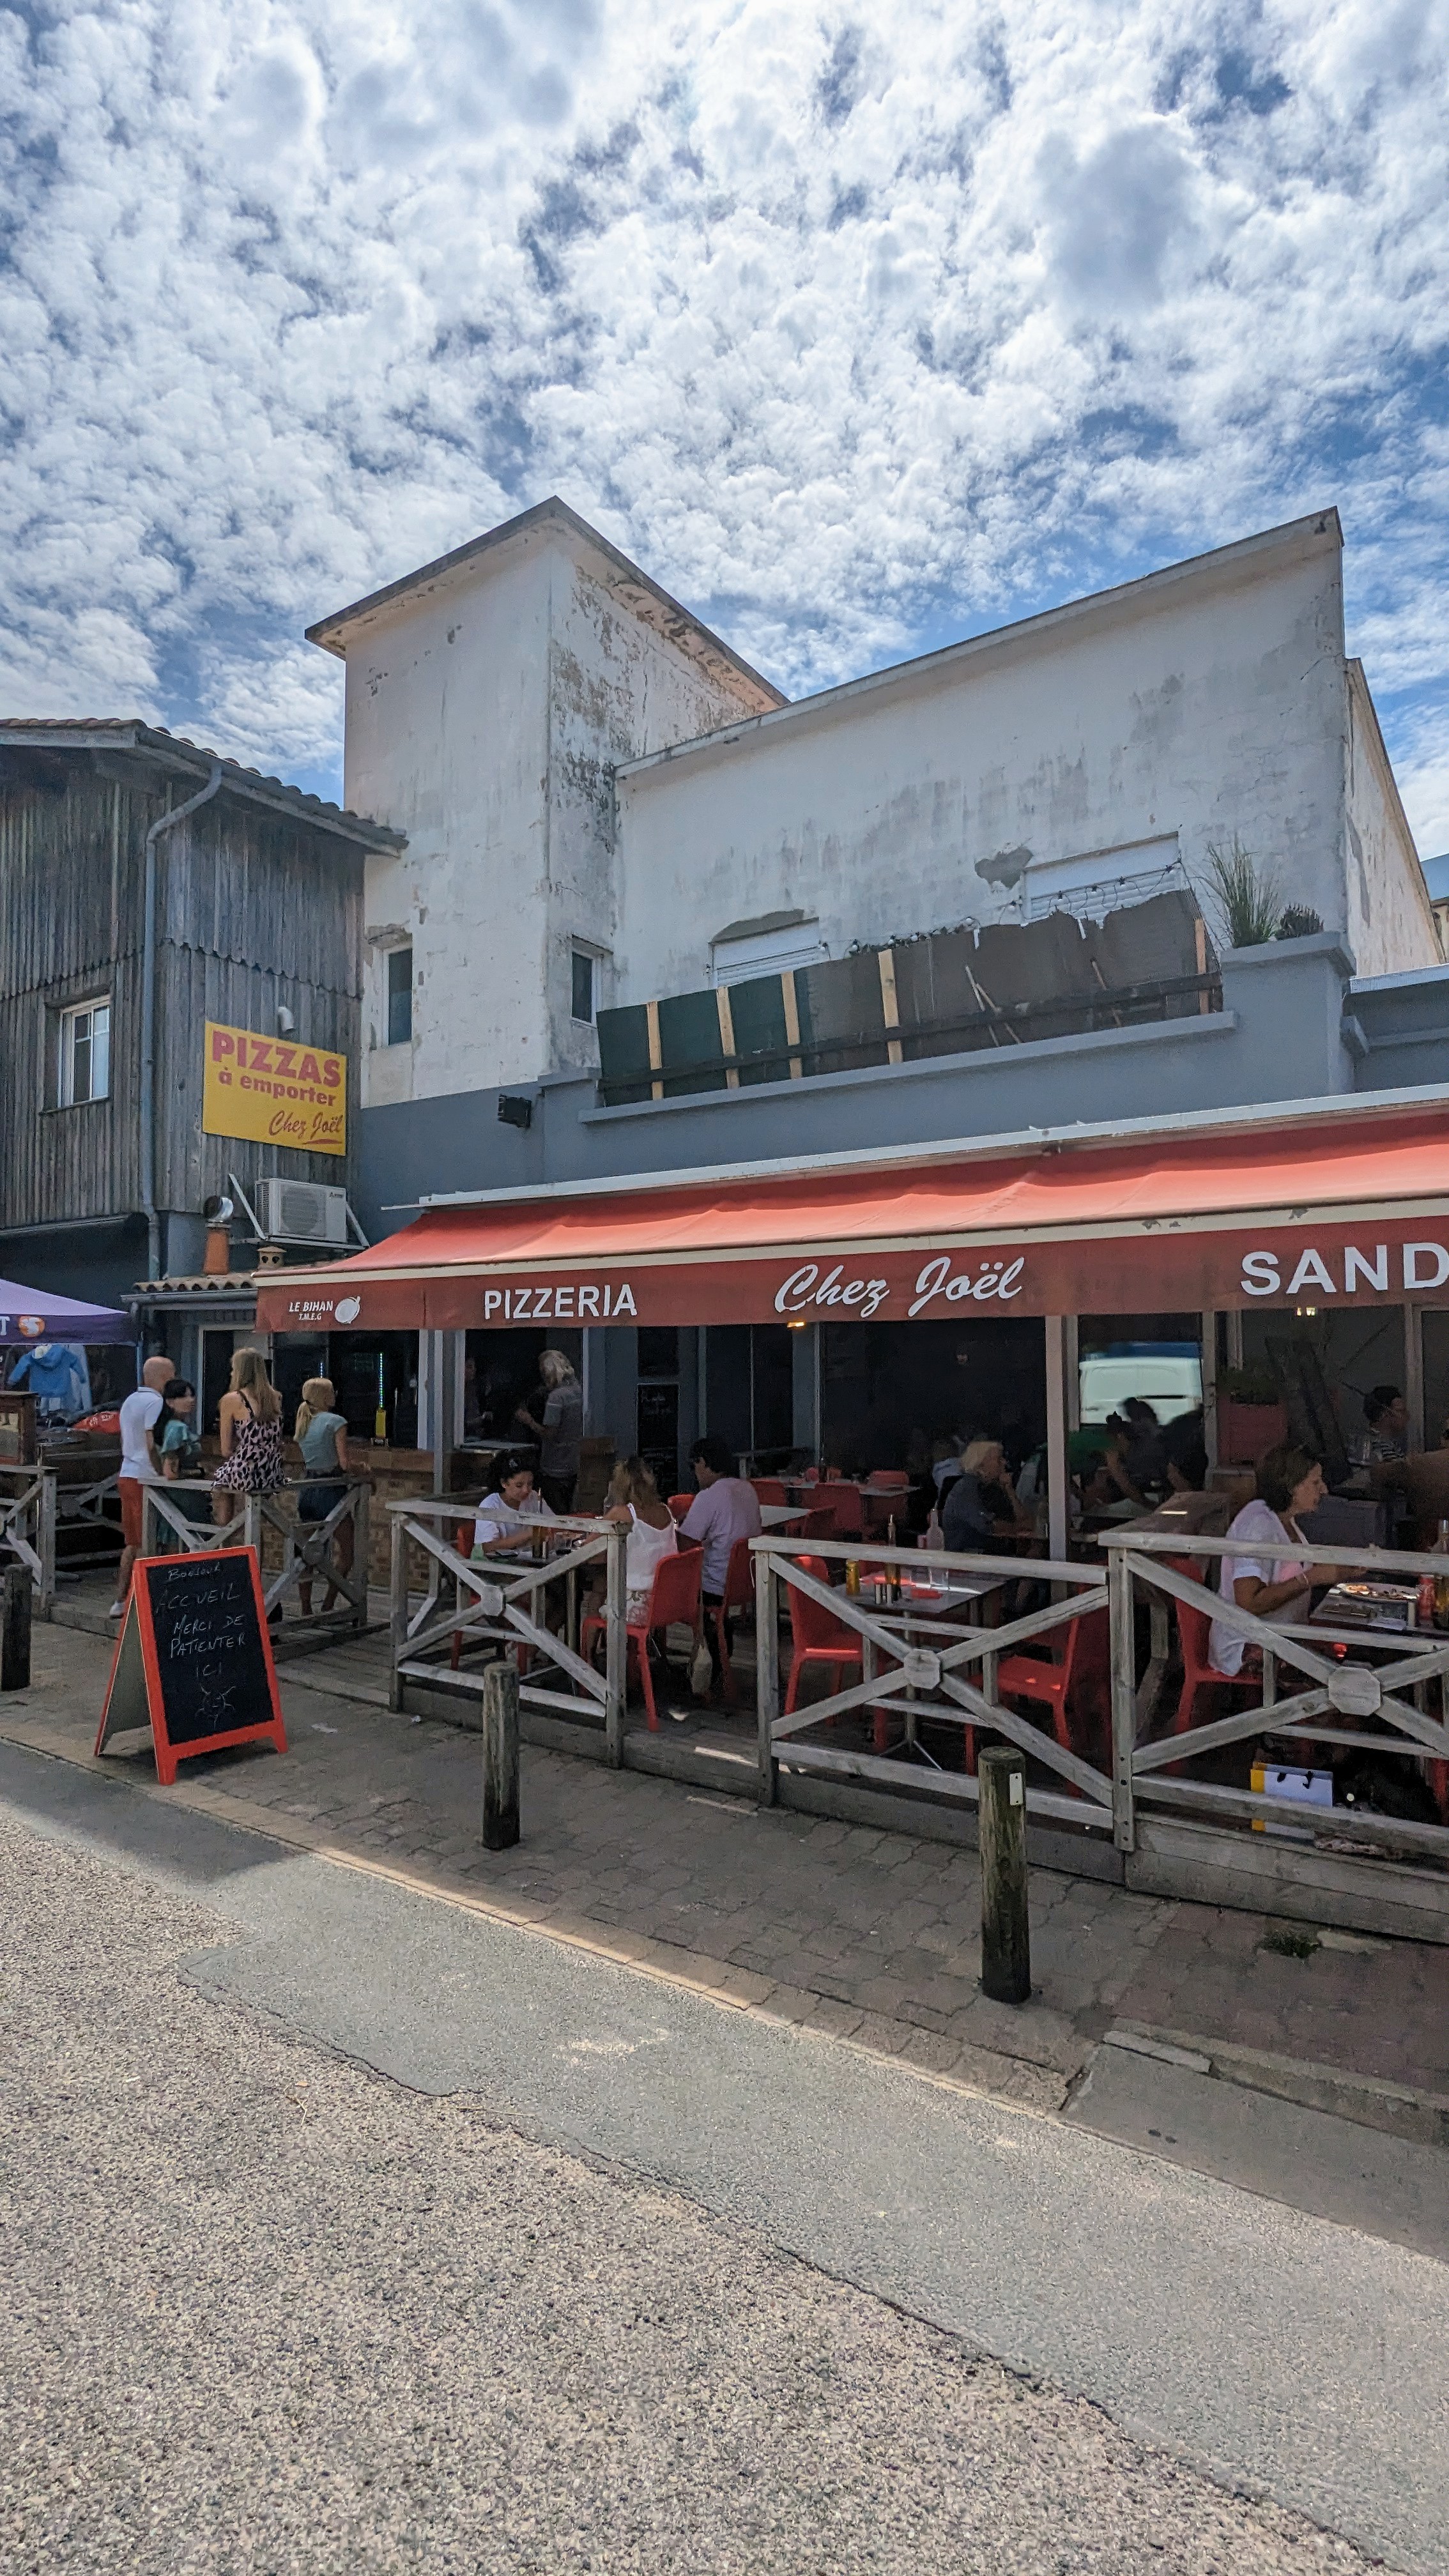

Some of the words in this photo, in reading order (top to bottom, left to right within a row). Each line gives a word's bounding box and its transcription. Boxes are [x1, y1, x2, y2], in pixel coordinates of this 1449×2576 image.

[213, 1031, 341, 1087] PIZZAS
[218, 1066, 232, 1085] à
[240, 1075, 337, 1107] emporter
[268, 1110, 307, 1139] Chez
[310, 1112, 344, 1140] Joël
[1241, 1242, 1449, 1296] SAND
[484, 1284, 638, 1320] PIZZERIA
[774, 1264, 890, 1318] Chez
[908, 1256, 1025, 1317] Joël
[289, 1301, 301, 1312] LE
[302, 1300, 334, 1312] BIHAN
[174, 1614, 212, 1634] MERCI
[223, 1614, 244, 1629] DE
[171, 1632, 245, 1658] PATIENTER
[196, 1661, 222, 1678] ICI
